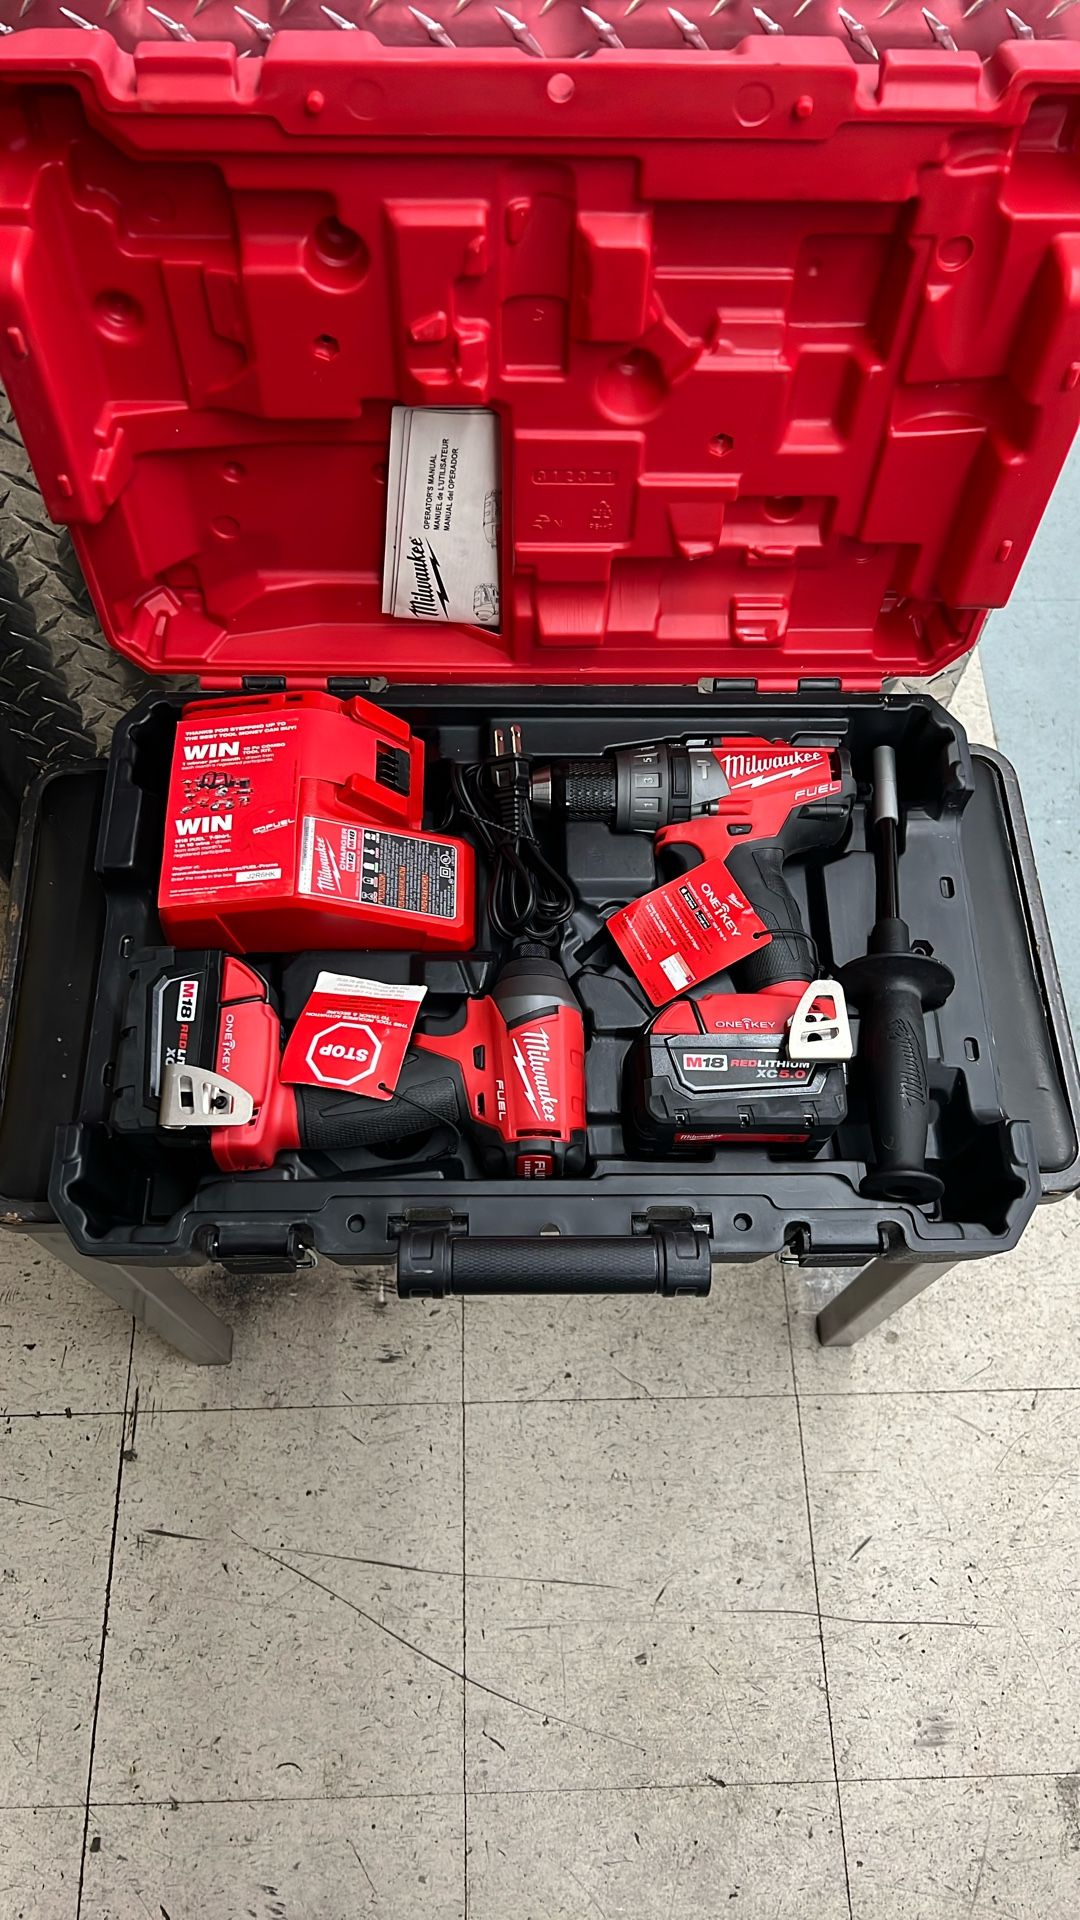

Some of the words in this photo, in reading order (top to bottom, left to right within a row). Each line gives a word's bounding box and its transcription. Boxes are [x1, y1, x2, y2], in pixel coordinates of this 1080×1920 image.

[428, 454, 437, 484] MANUAL
[438, 438, 449, 491] L'UTILISATEUR
[437, 492, 444, 501] de
[443, 503, 453, 531] MANUAL
[449, 448, 459, 489] OPERADOR
[423, 484, 434, 530] OPERATOR'S
[434, 502, 443, 530] MANUEL
[406, 536, 440, 617] Milwaukee
[184, 742, 240, 760] WIN
[720, 751, 823, 780] Milwaukee
[794, 782, 839, 801] FUEL
[175, 814, 233, 836] WIN
[348, 830, 357, 849] M18
[317, 836, 337, 892] Milwaukee
[339, 828, 349, 871] CHARGER
[347, 852, 355, 872] M12
[181, 983, 195, 1019] M18
[177, 1024, 189, 1065] REDLIT
[319, 1043, 369, 1062] STOP
[520, 1027, 558, 1122] Milwaukee
[686, 1057, 725, 1068] M18
[730, 1059, 810, 1069] REDLITHIUM
[756, 1069, 806, 1079] XC5.0
[495, 1079, 506, 1120] FUEL
